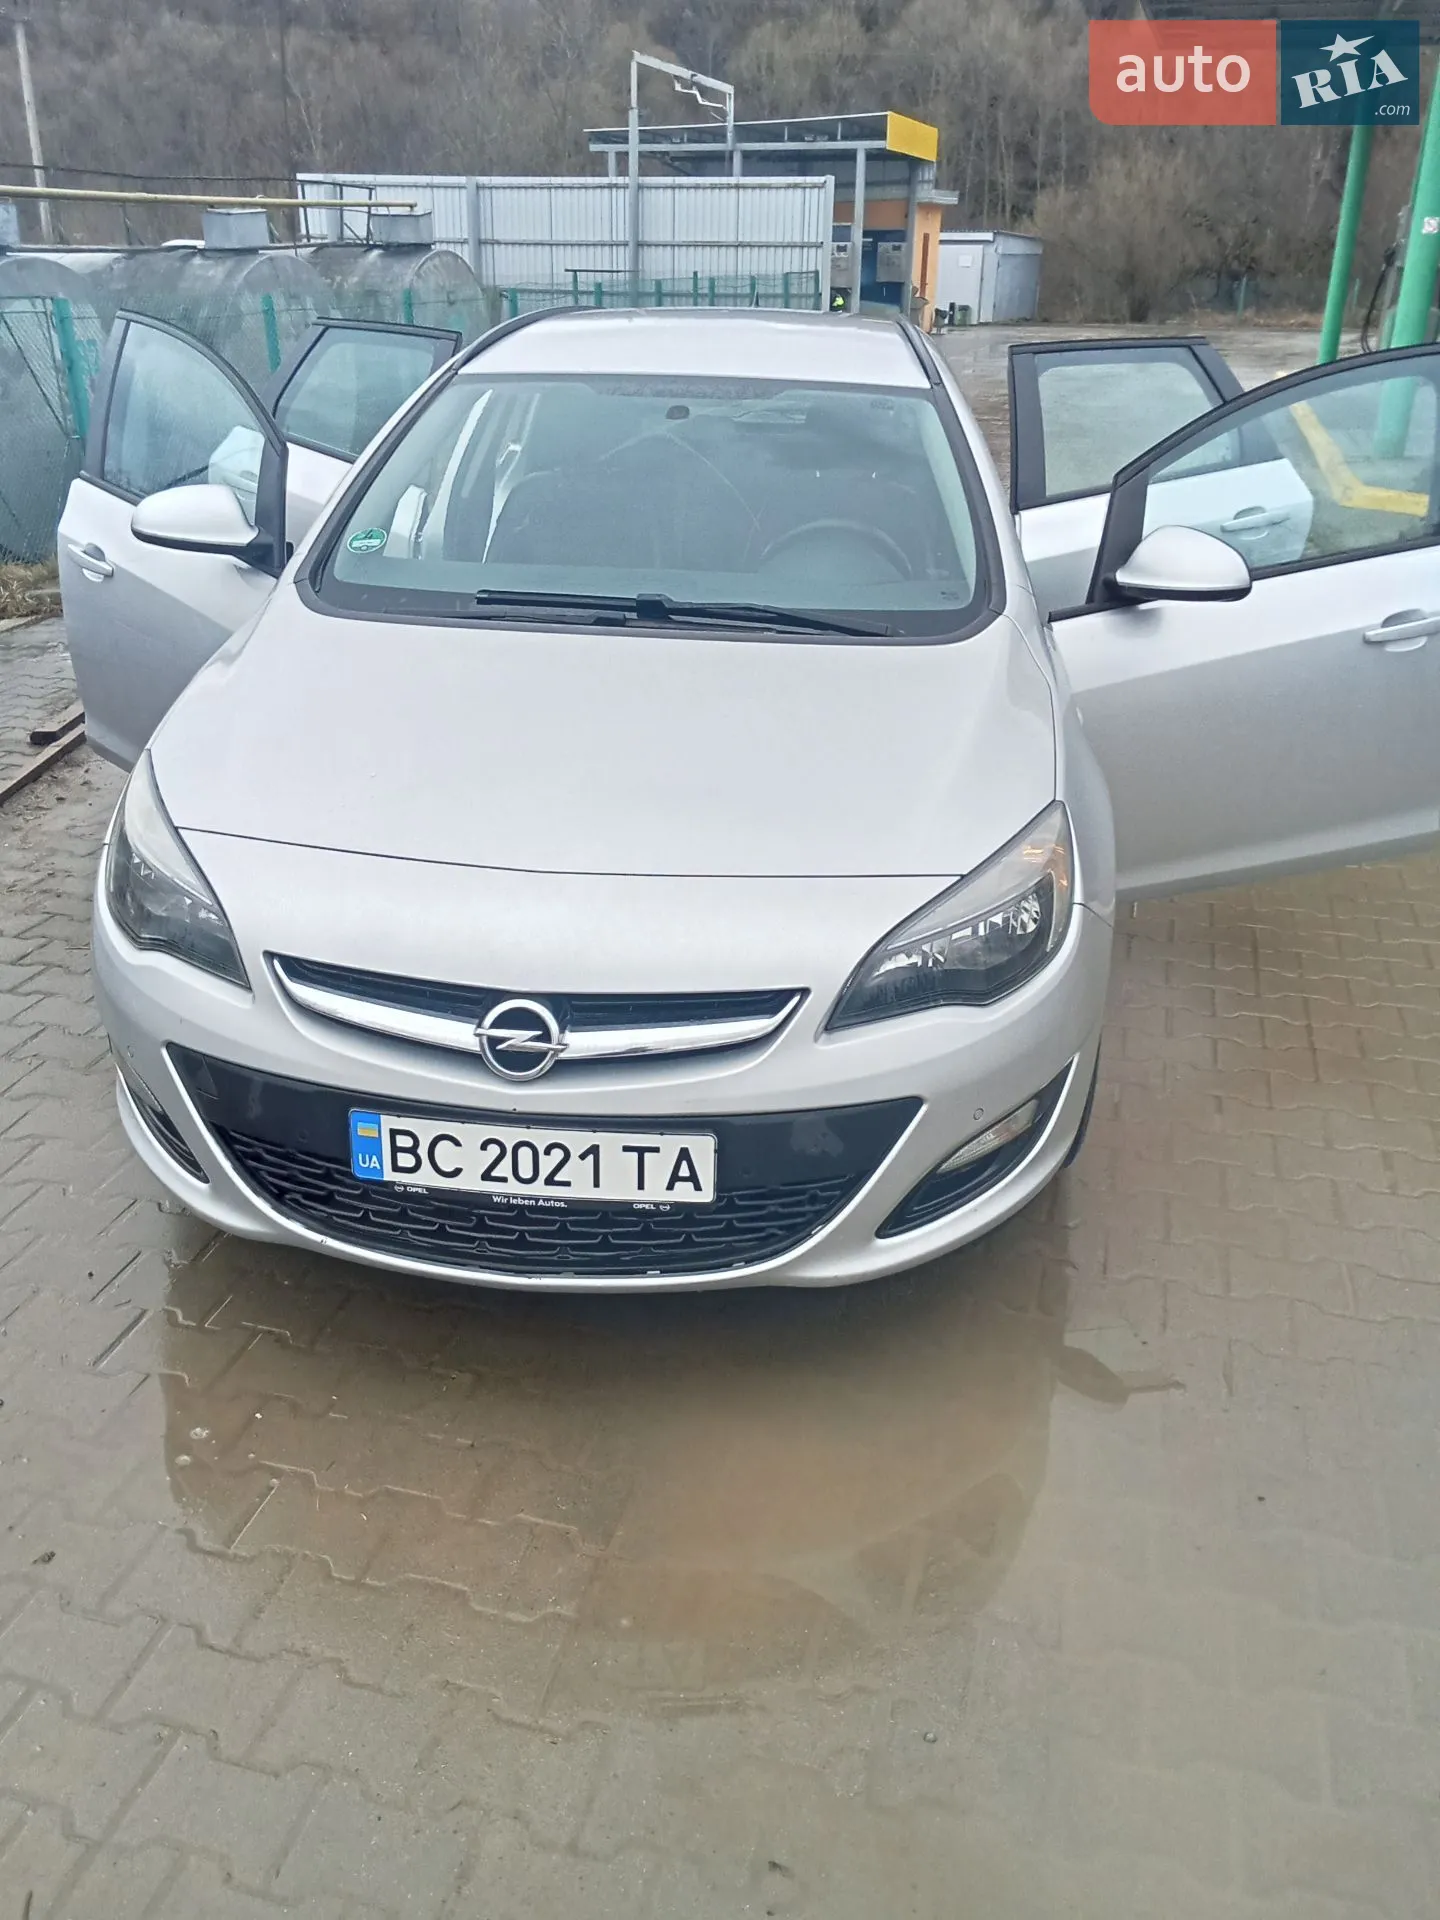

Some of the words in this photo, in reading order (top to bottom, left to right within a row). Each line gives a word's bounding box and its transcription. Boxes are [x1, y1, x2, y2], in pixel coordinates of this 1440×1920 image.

[358, 1152, 381, 1170] UA
[388, 1127, 464, 1179] BC
[479, 1136, 601, 1189] 2021
[621, 1144, 704, 1192] TA
[406, 1185, 429, 1194] OPEL
[492, 1195, 508, 1204] Wir
[510, 1196, 536, 1206] leben
[537, 1198, 568, 1208] Autos.
